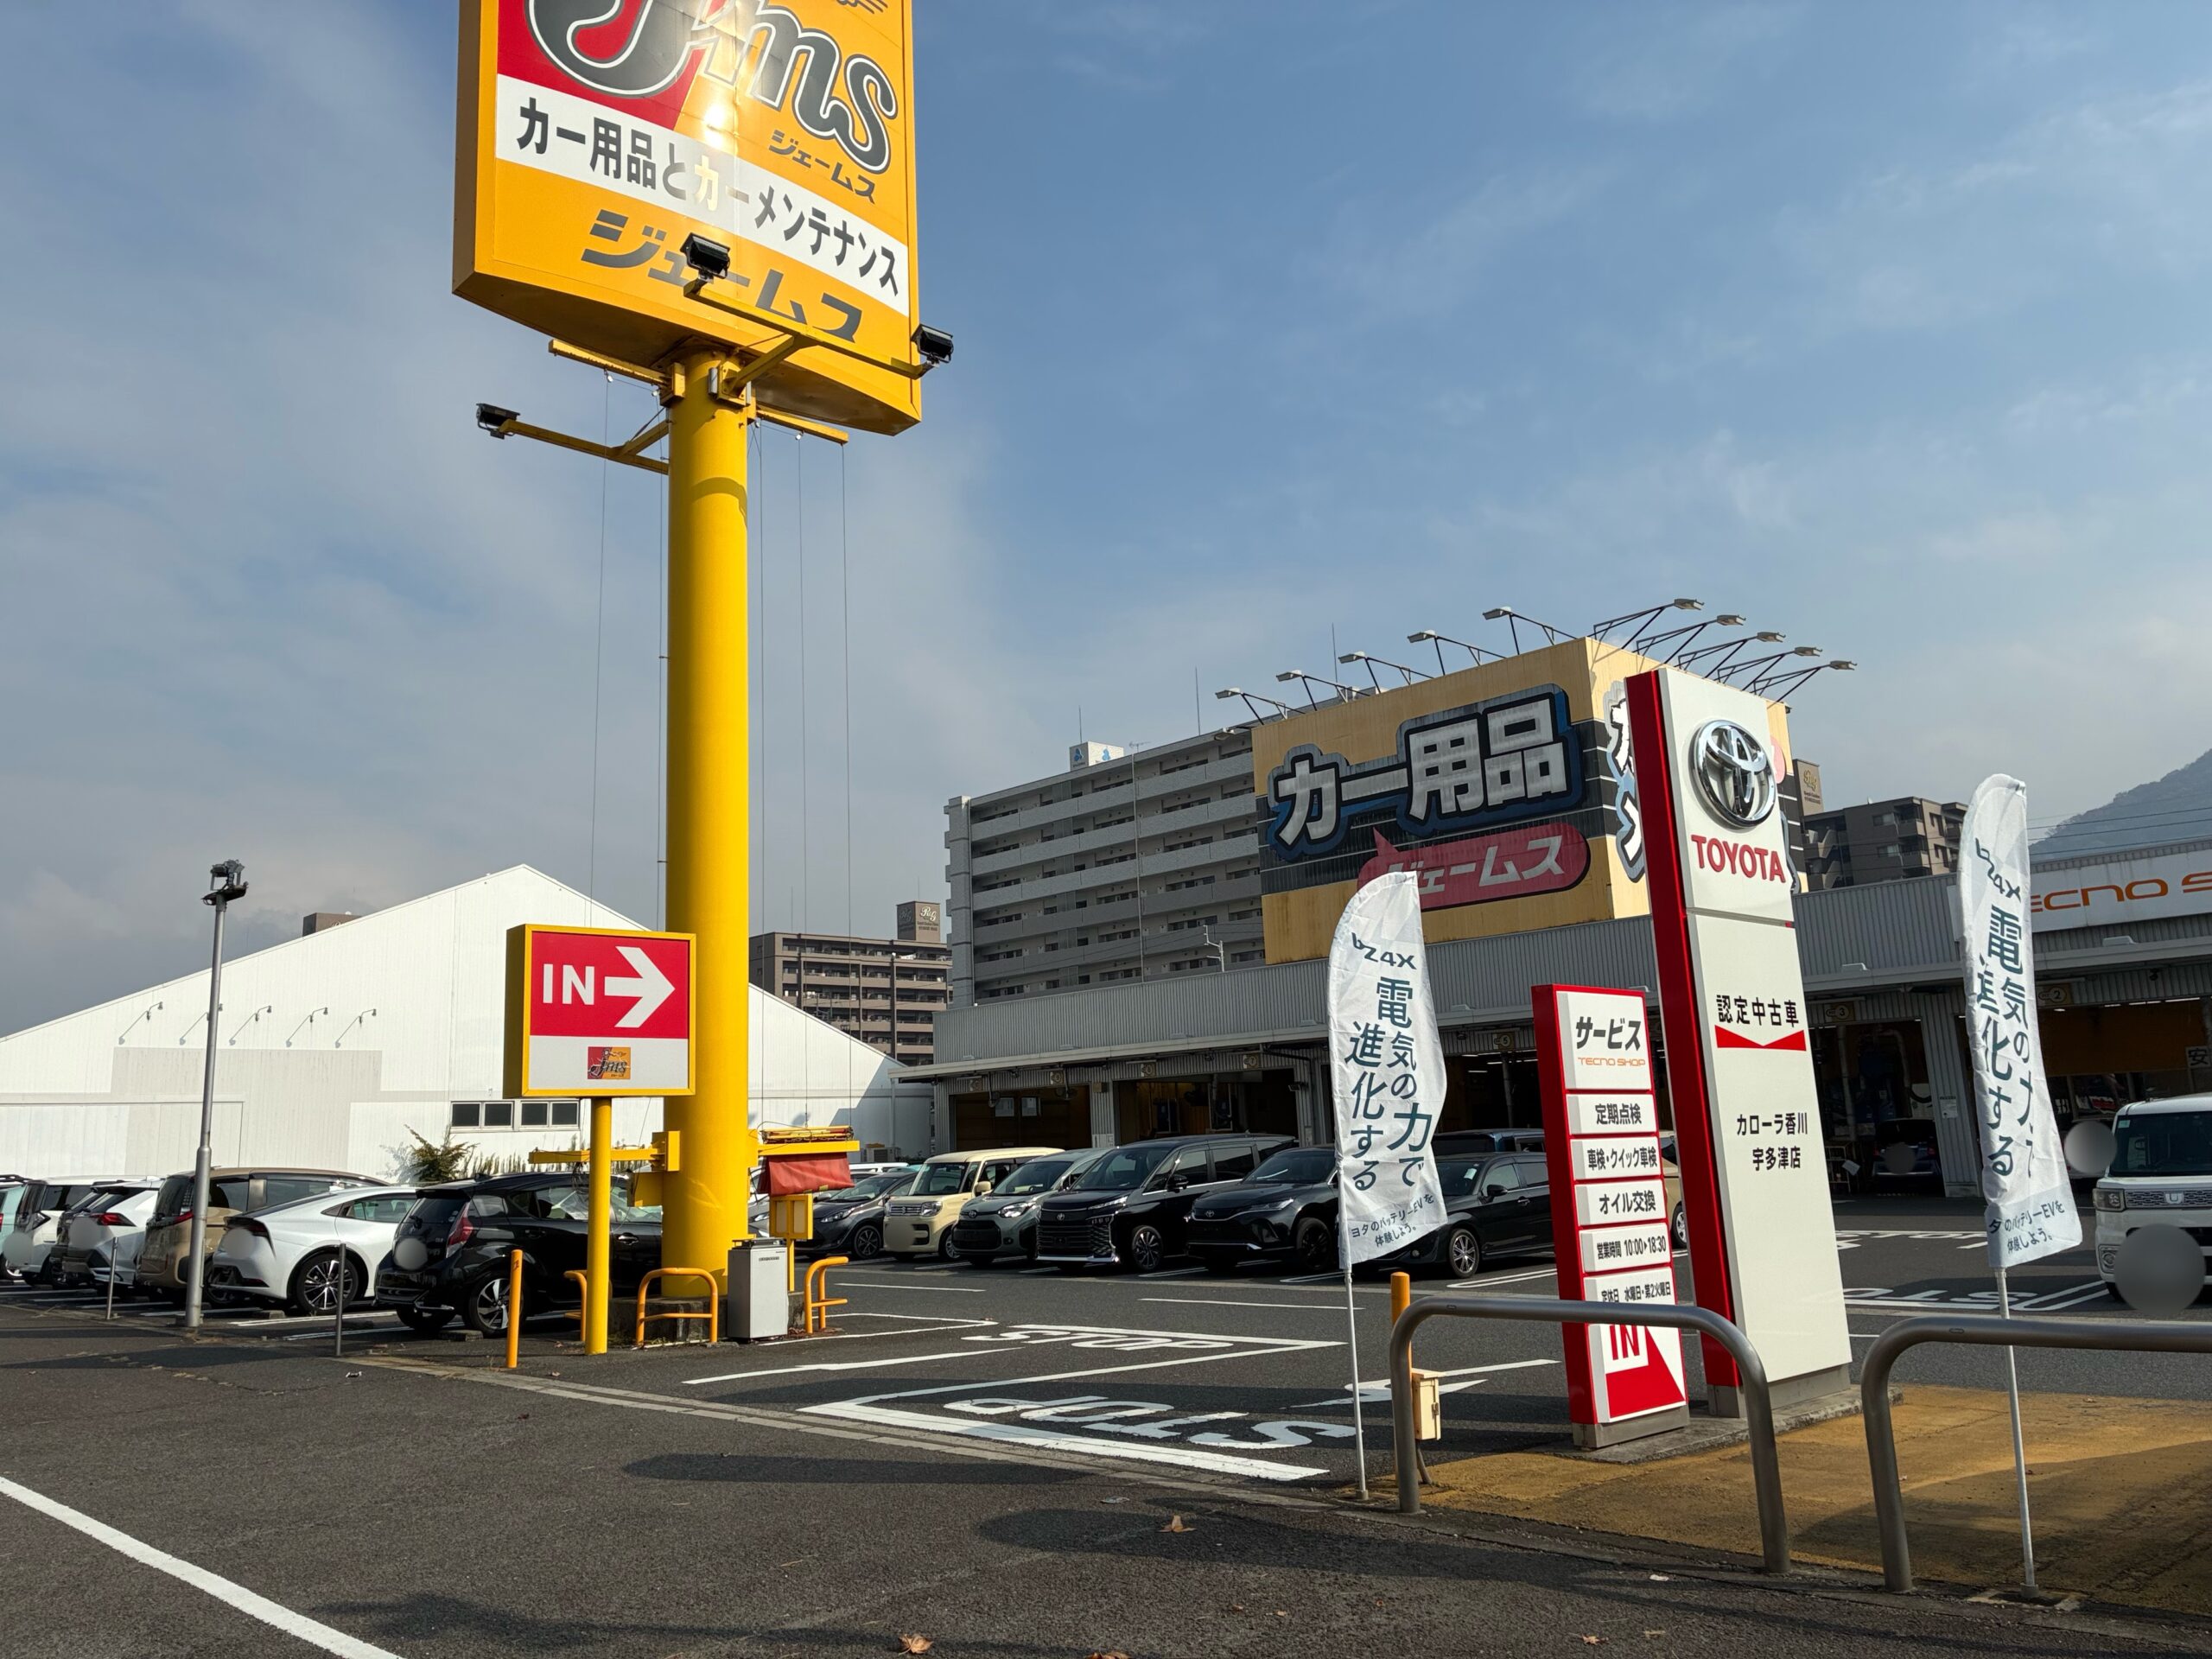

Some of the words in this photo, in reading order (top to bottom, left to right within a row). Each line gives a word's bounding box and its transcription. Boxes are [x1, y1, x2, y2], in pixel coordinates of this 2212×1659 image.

[768, 129, 876, 205] ジェームス
[516, 96, 899, 296] カー用品とカーメンテナンス
[1277, 698, 1567, 849] カー用品
[1691, 834, 1786, 883] TOYOTA
[1351, 931, 1417, 970] bZ4X
[543, 963, 594, 1005] IN
[2053, 990, 2063, 1000] 2
[1716, 995, 1799, 1027] 認定中古車
[1839, 1007, 1846, 1016] 3
[1575, 1016, 1642, 1052] サービス
[1577, 1057, 1616, 1066] TECNO
[1617, 1058, 1646, 1067] SHOP
[2187, 1048, 2209, 1066] 安
[1376, 976, 1433, 1188] 電気の力で
[1344, 1020, 1388, 1192] 進化する
[1595, 1103, 1642, 1125] 定期点検
[1737, 1112, 1808, 1136] カローラ香川
[1586, 1146, 1657, 1171] 車検・クイック車検
[1752, 1146, 1801, 1171] 宇多津店
[1599, 1190, 1656, 1215] オイル交換
[1351, 1193, 1434, 1238] ヨタのバッテリーEVを
[1375, 1223, 1417, 1247] 体験しよう。
[1597, 1240, 1622, 1260] 営業時間
[1624, 1281, 1671, 1302] 水曜日・第2火曜日
[1842, 1287, 2037, 1303] STO
[961, 1330, 1234, 1351] STOP
[1609, 1323, 1640, 1361] IN
[943, 1395, 1363, 1450] STOP
